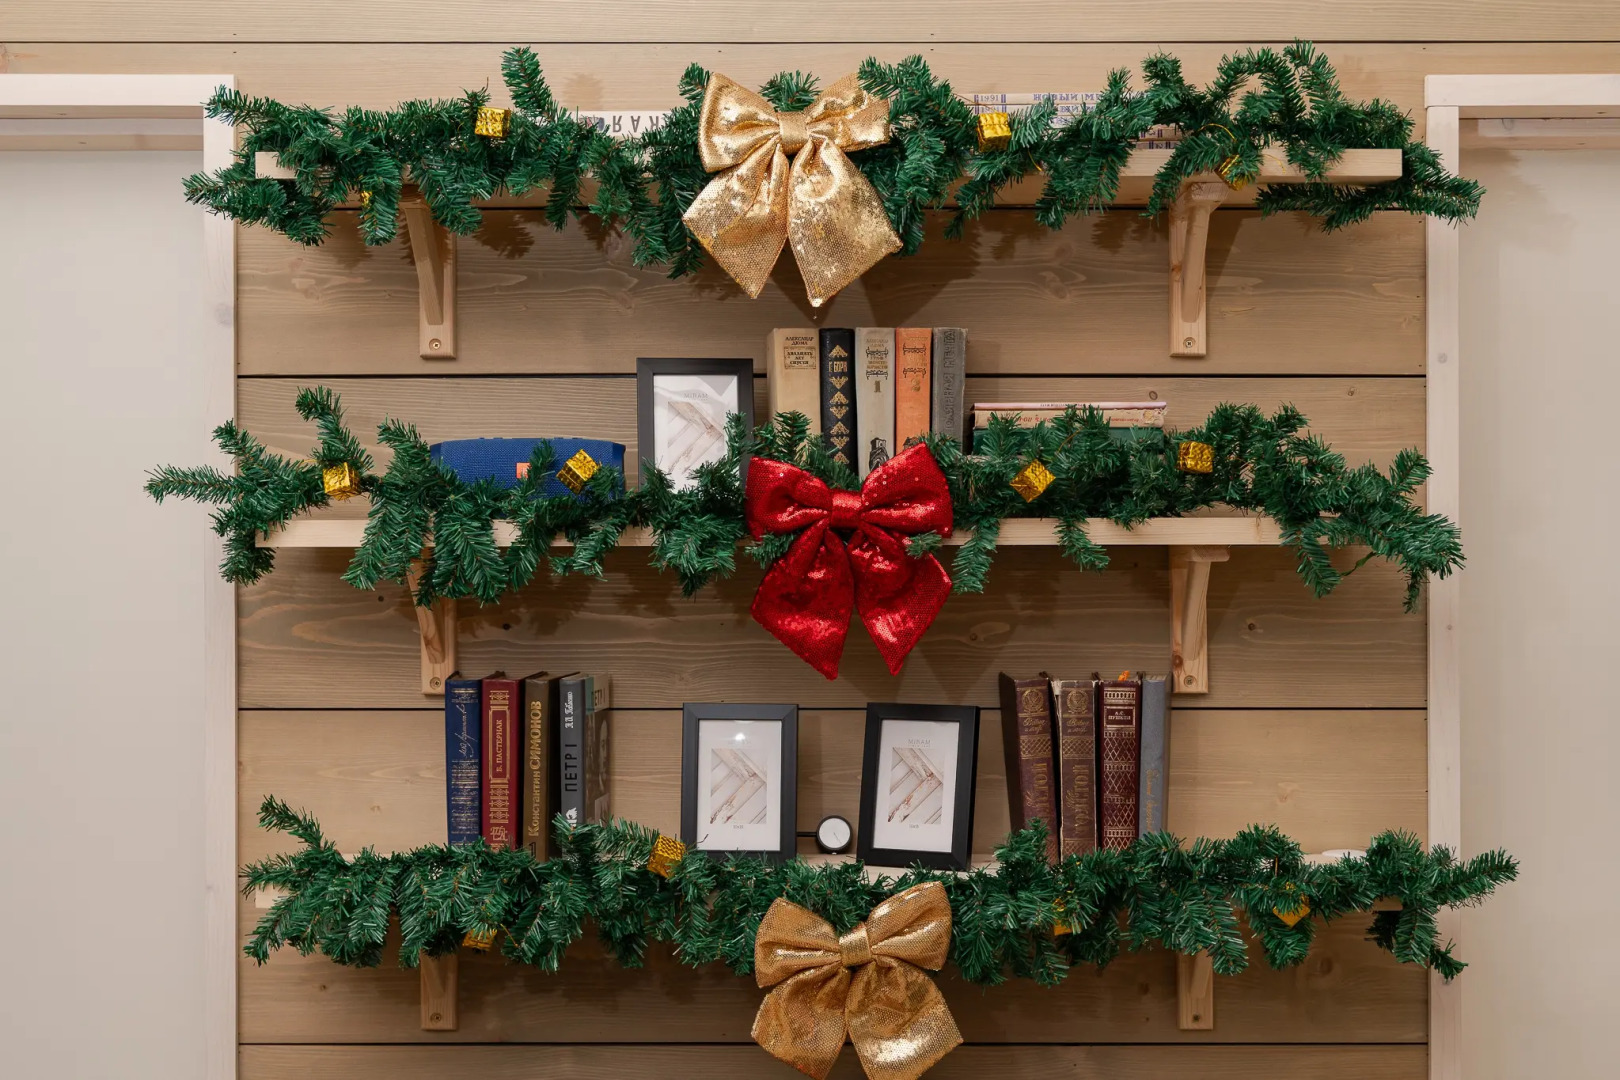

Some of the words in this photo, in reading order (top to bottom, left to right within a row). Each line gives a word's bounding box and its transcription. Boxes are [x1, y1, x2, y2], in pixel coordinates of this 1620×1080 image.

[980, 94, 999, 102] 1991
[873, 380, 881, 393] 1
[529, 700, 543, 770] СИМОНОВ
[565, 752, 577, 792] ПЕТР
[528, 770, 541, 837] Константин
